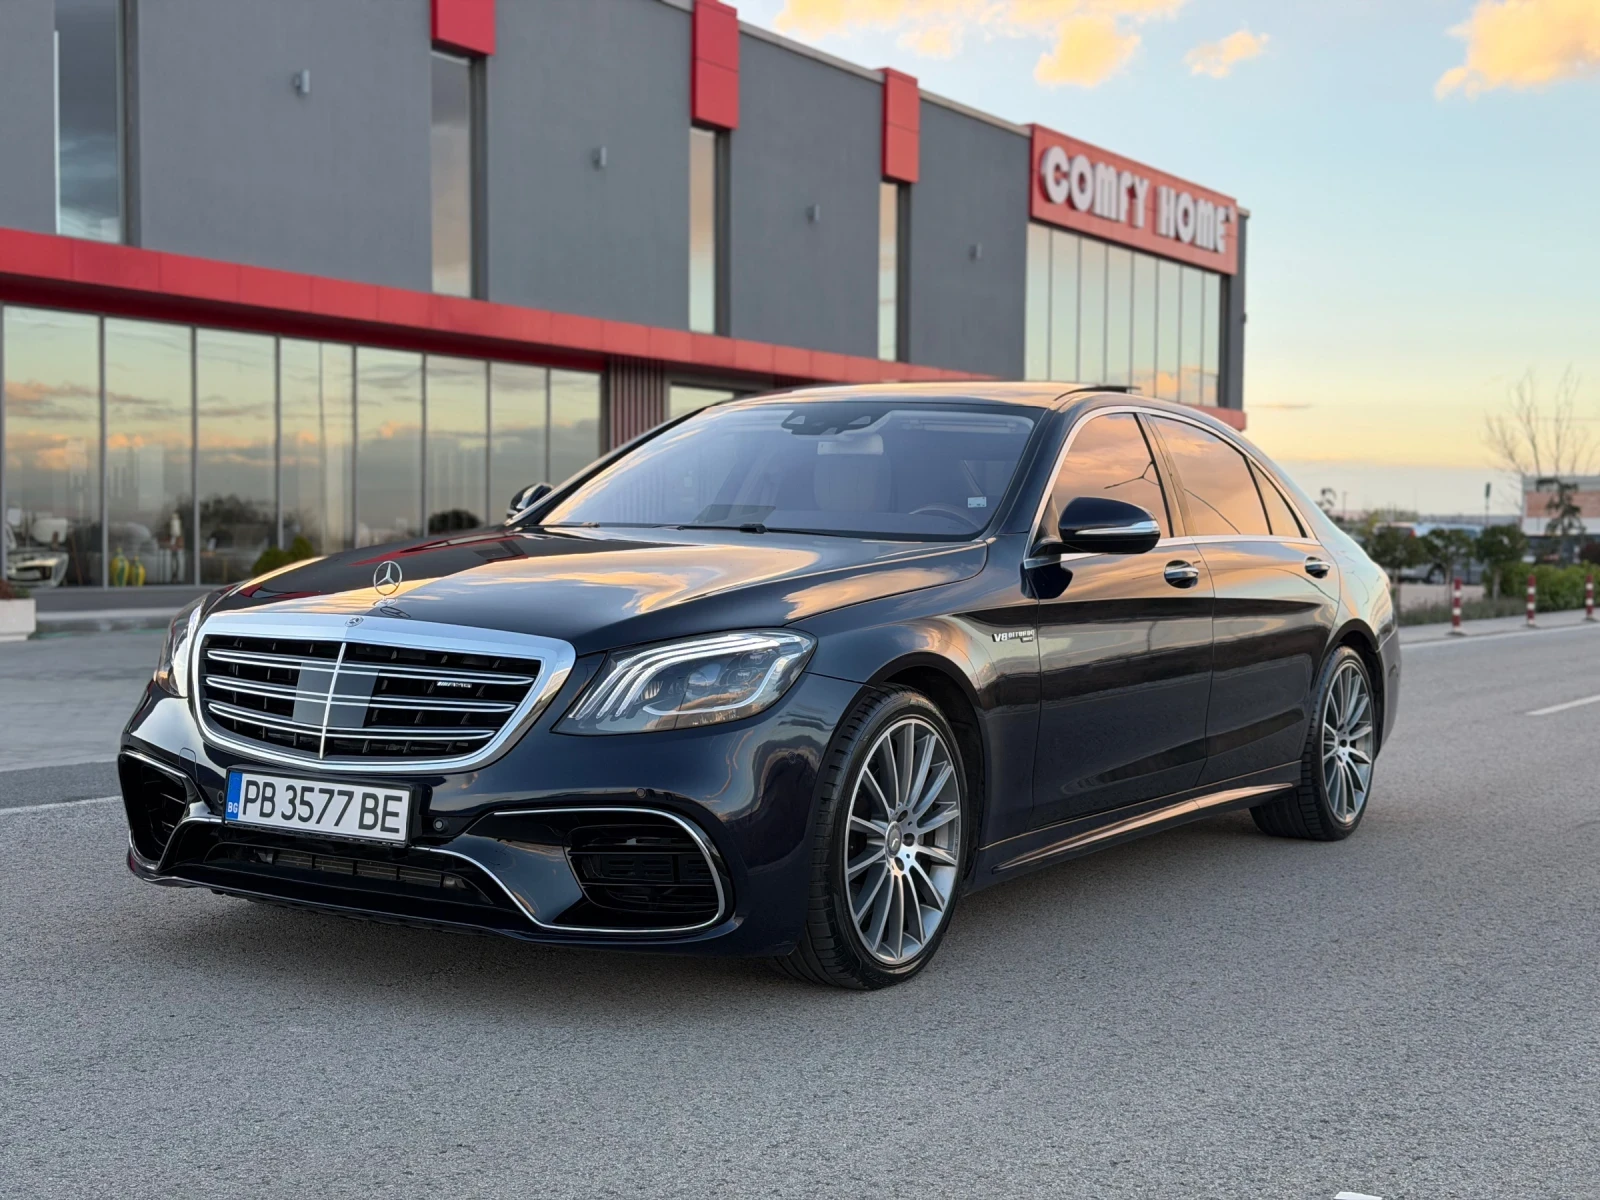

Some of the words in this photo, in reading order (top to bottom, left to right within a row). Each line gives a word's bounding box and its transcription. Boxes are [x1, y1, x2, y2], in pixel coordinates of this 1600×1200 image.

[1041, 145, 1148, 228] COMFY
[1157, 185, 1227, 254] HOME
[993, 632, 1008, 642] V8
[227, 801, 238, 814] BG
[242, 779, 276, 818] PB
[281, 784, 354, 827] 3577
[358, 792, 403, 834] BE
